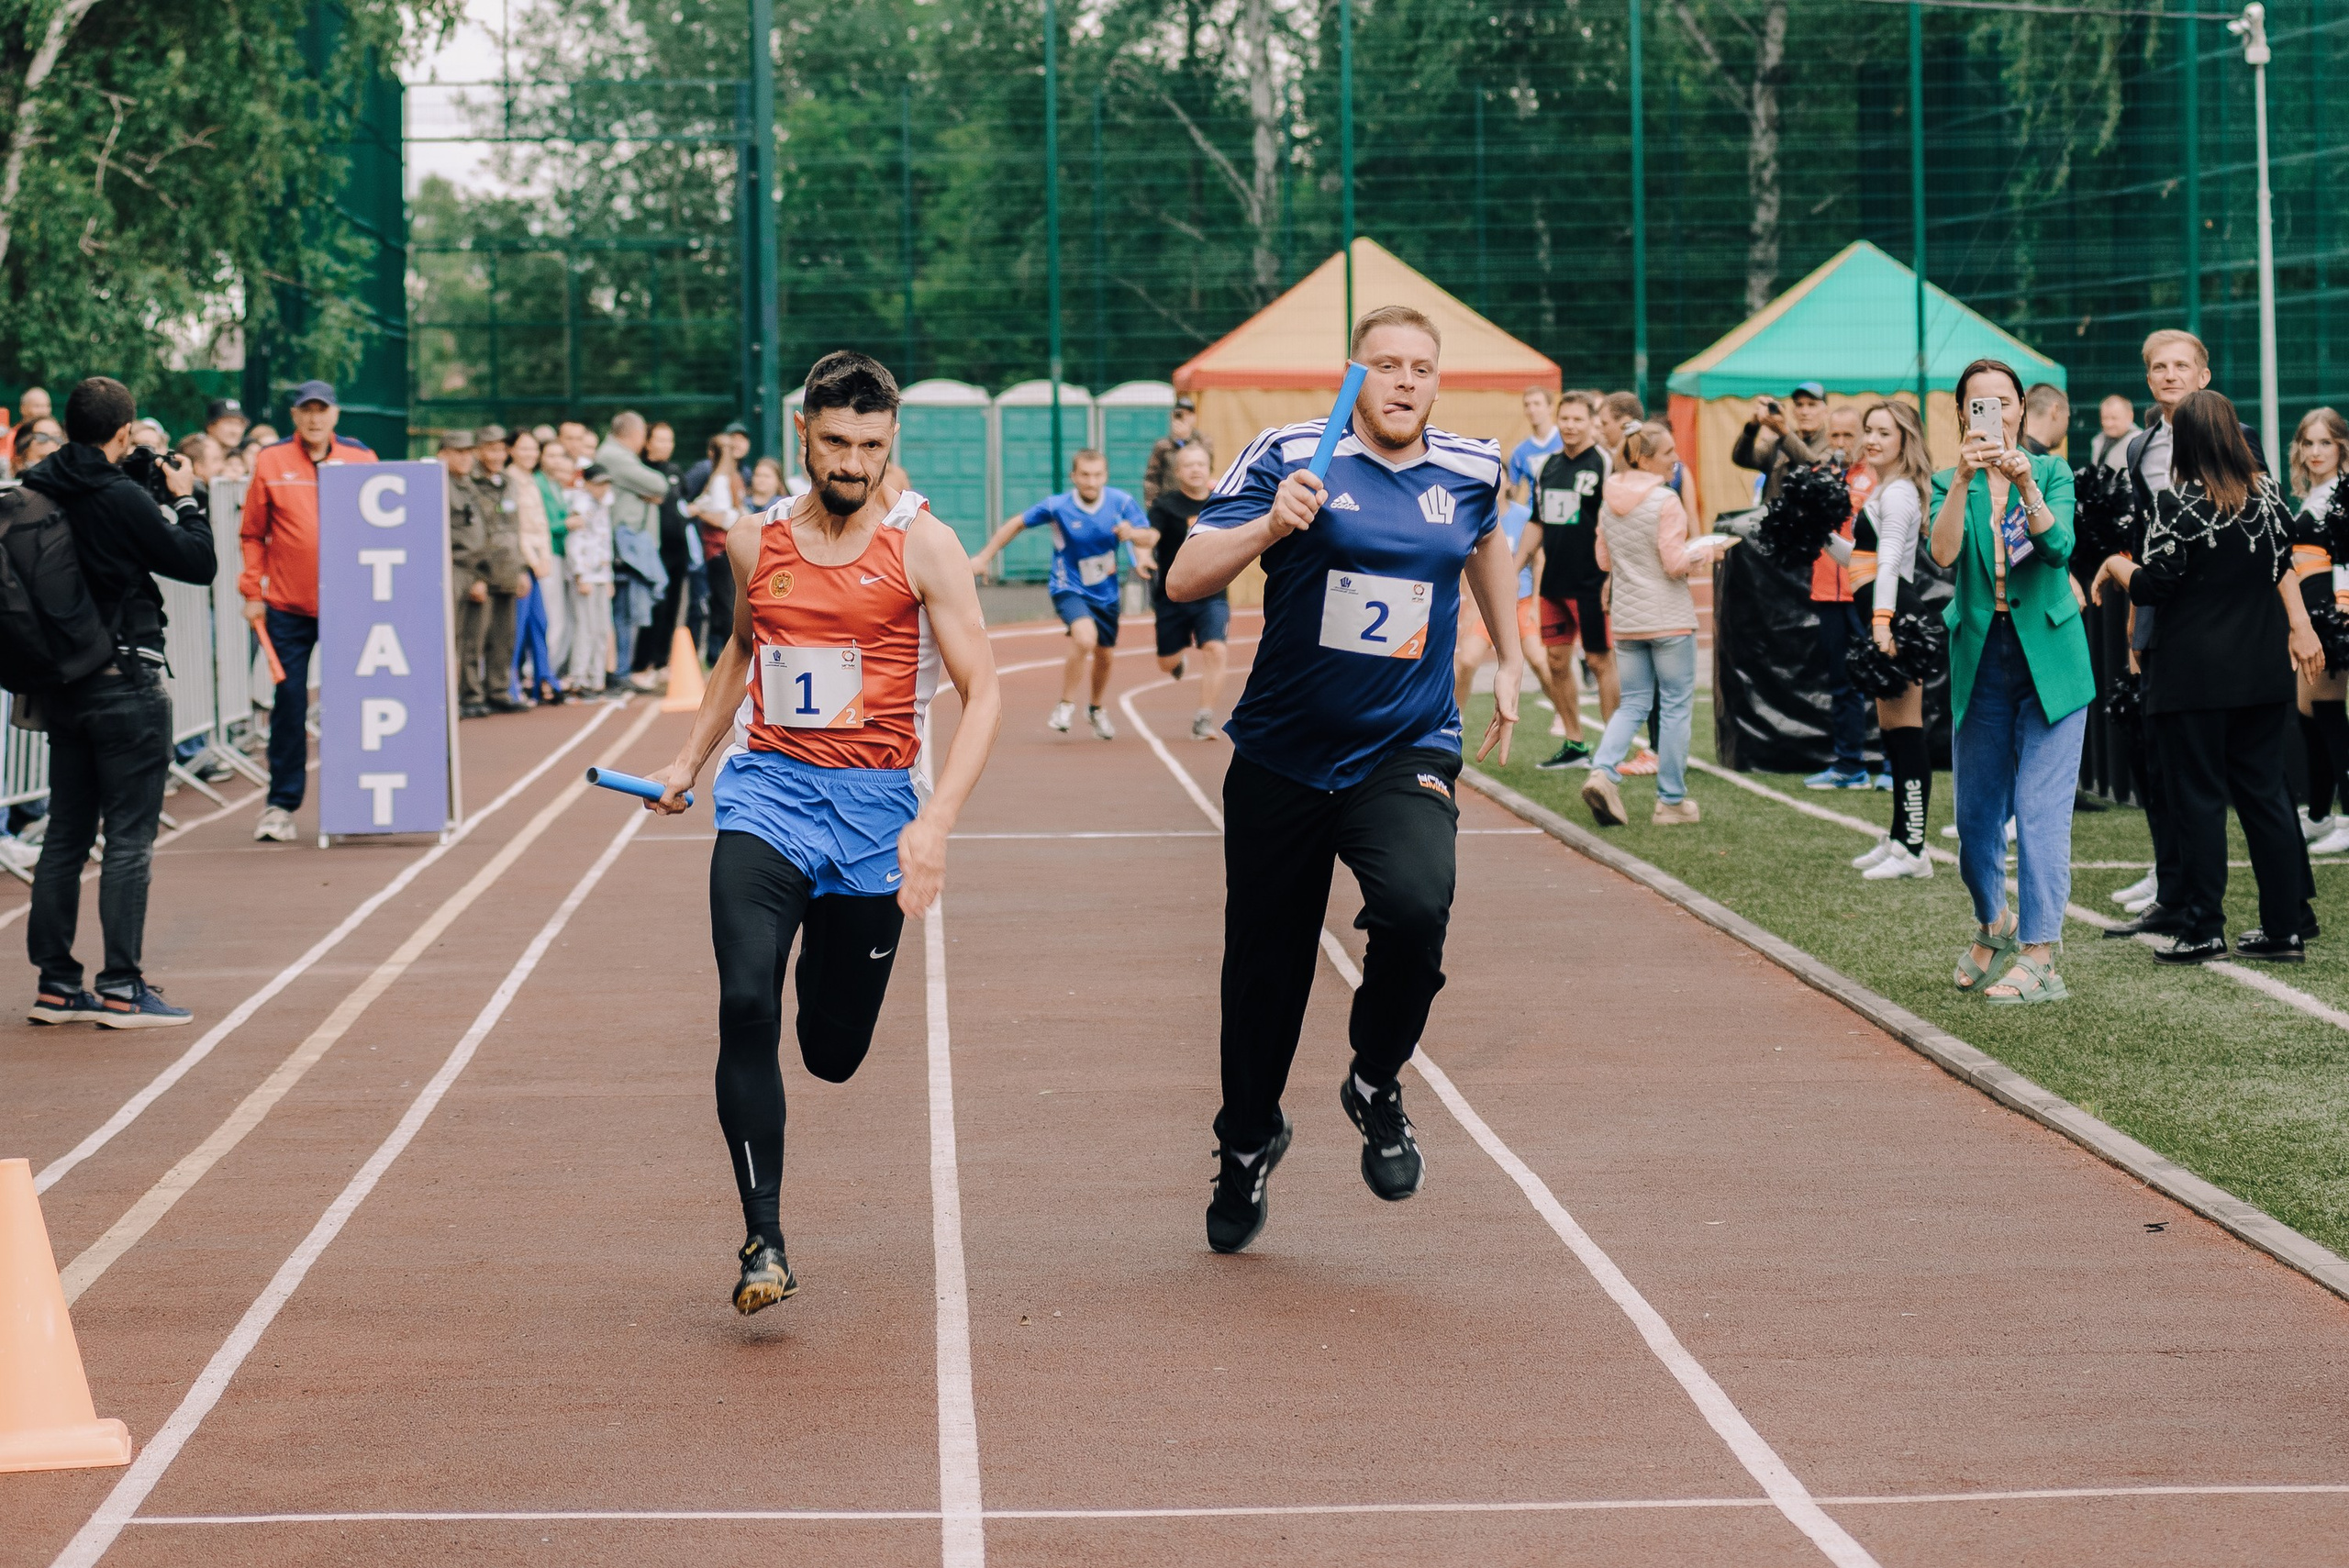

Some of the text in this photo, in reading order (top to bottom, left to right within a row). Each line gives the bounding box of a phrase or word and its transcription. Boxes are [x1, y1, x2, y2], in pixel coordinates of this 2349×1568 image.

[1575, 471, 1598, 495] 12
[1557, 502, 1564, 517] 1
[1361, 601, 1389, 642] 2
[355, 473, 410, 826] СТАРТ
[1408, 639, 1419, 655] 2
[796, 673, 819, 714] 1
[846, 708, 856, 724] 2
[1904, 779, 1924, 844] Winline
